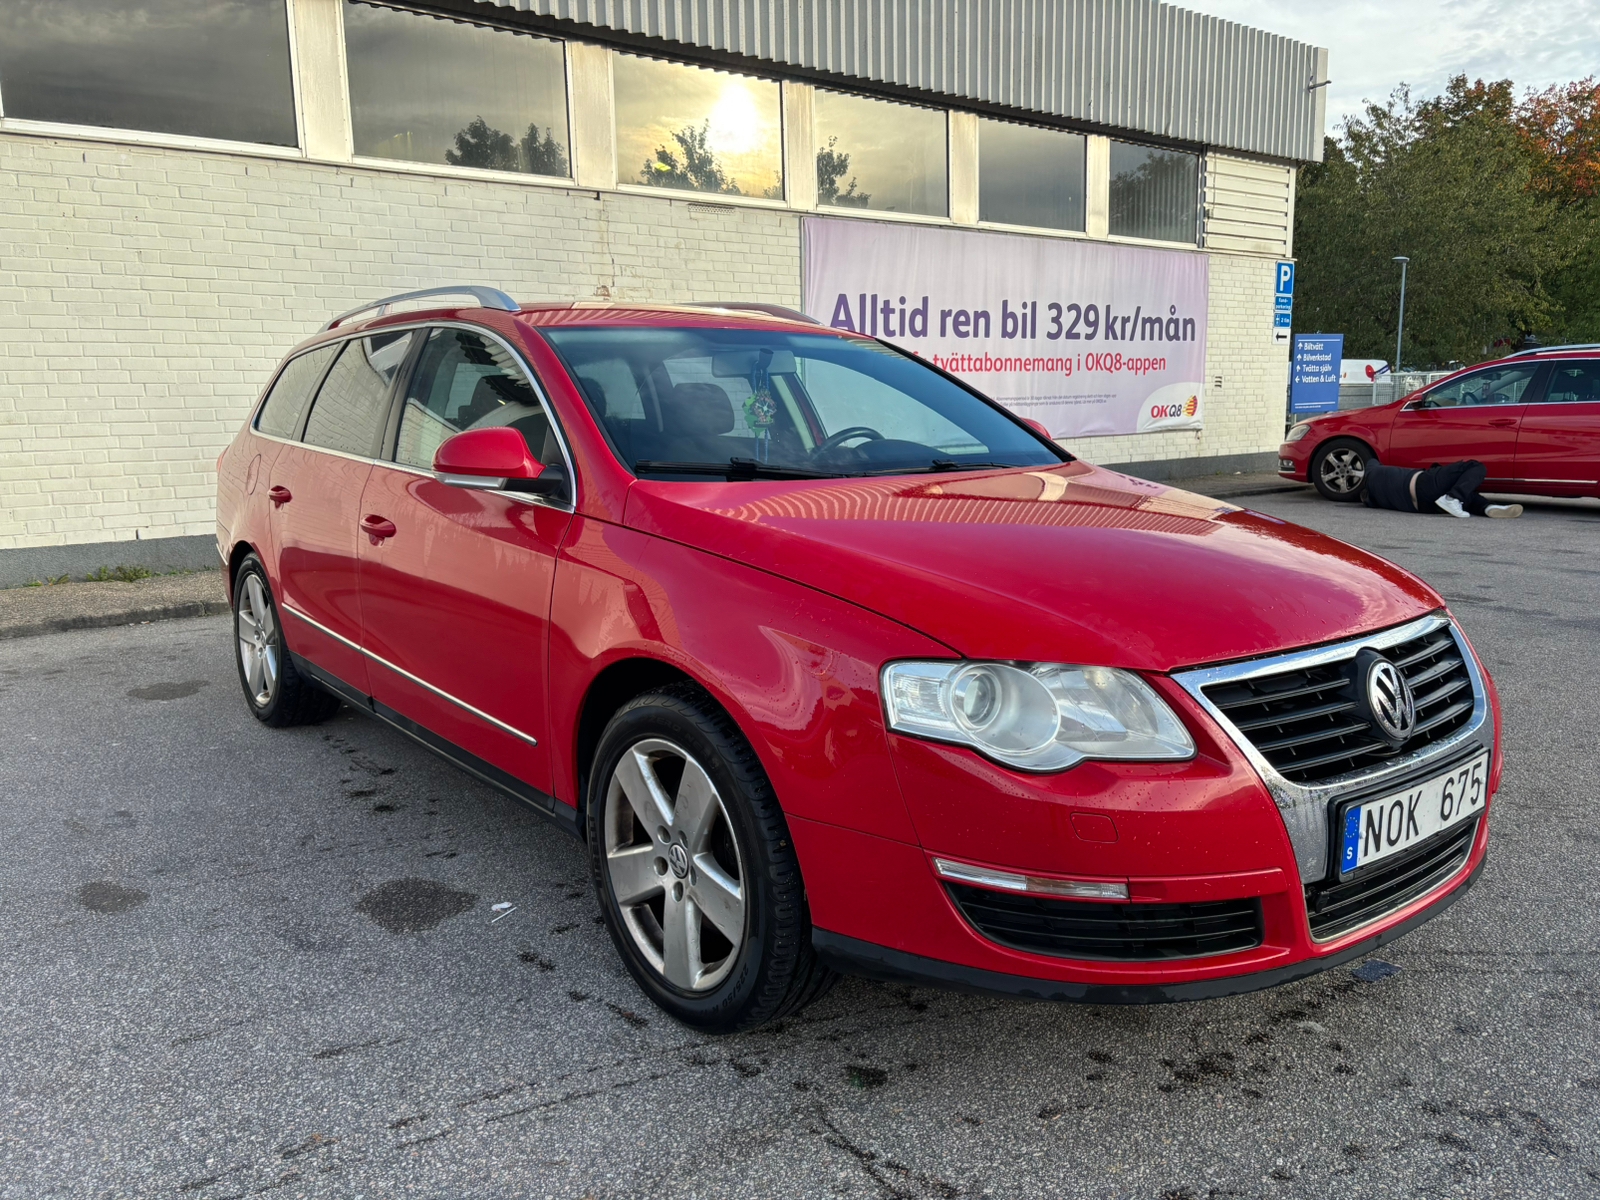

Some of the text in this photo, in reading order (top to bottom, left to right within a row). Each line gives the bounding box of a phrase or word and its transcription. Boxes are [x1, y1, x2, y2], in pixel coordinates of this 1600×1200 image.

[1280, 265, 1291, 292] P
[830, 293, 1196, 342] Alltid ren bil 329 kr/mån
[1303, 342, 1323, 350] Biltvätt
[1303, 353, 1331, 361] Bilverkstad
[933, 352, 1072, 377] tvättabonnemang
[1077, 353, 1081, 371] i
[1085, 353, 1166, 376] OKQ8-appen
[1302, 364, 1332, 373] Tvätta själv
[1302, 375, 1319, 383] Vatten
[1325, 374, 1336, 382] Luft
[1150, 404, 1182, 418] OKQ8
[1346, 761, 1483, 860] S NOK 675
